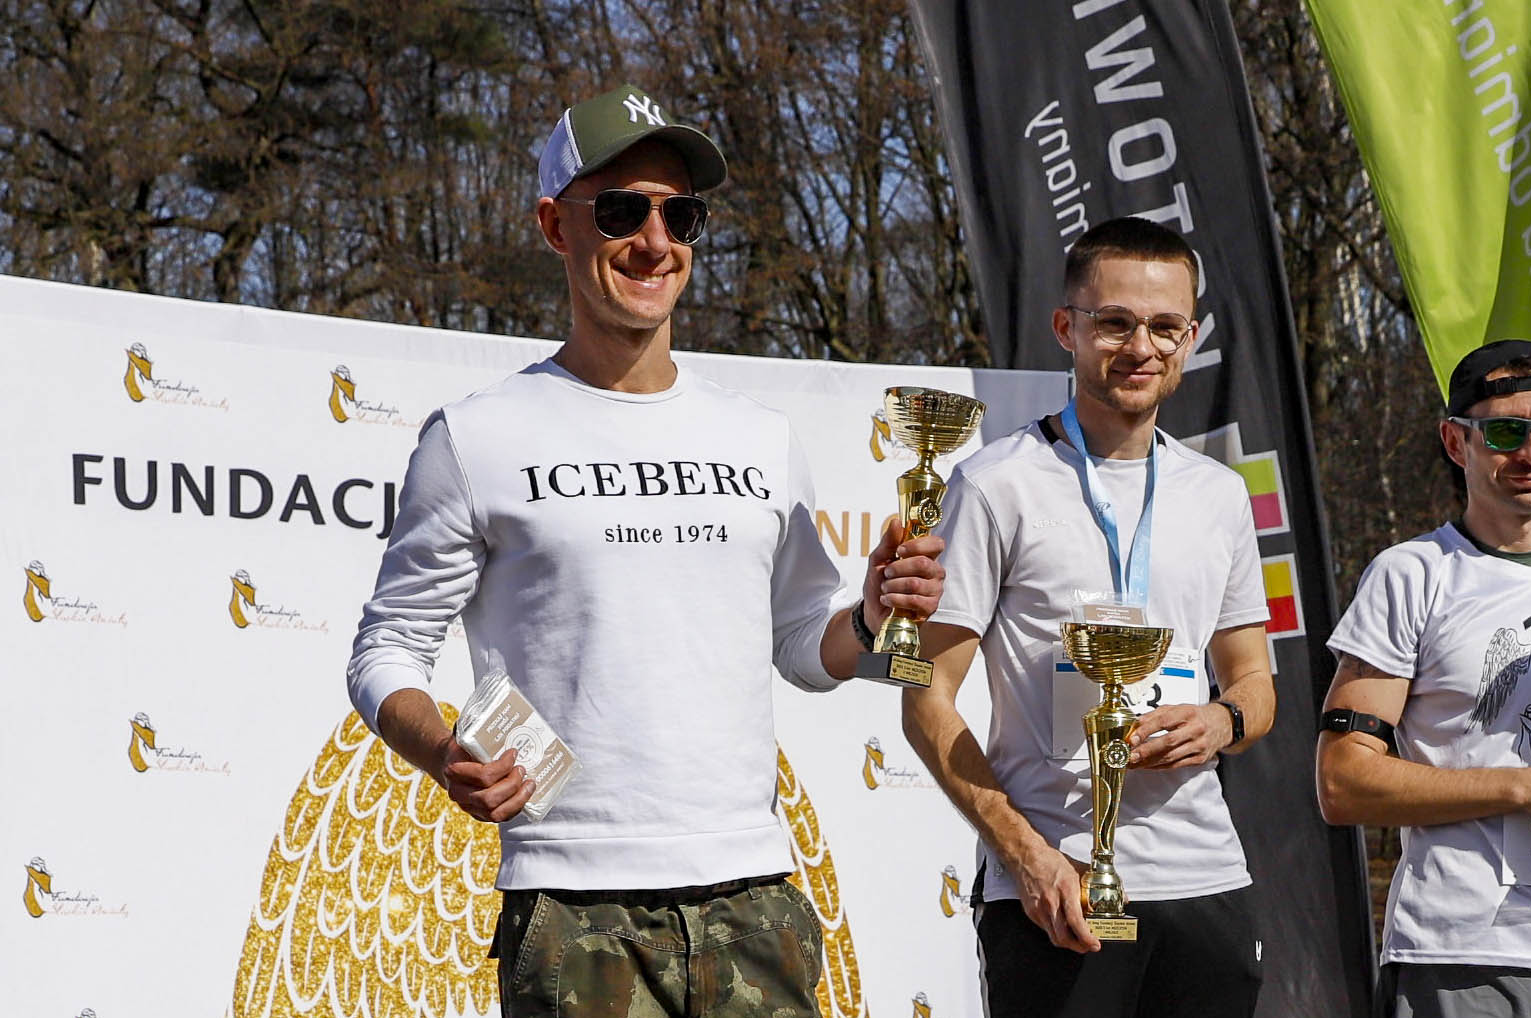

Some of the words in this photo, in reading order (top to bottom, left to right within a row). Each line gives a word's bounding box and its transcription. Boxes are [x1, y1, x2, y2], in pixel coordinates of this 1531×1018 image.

[520, 461, 771, 503] ICEBERG
[604, 523, 663, 543] since
[673, 523, 729, 544] 1974
